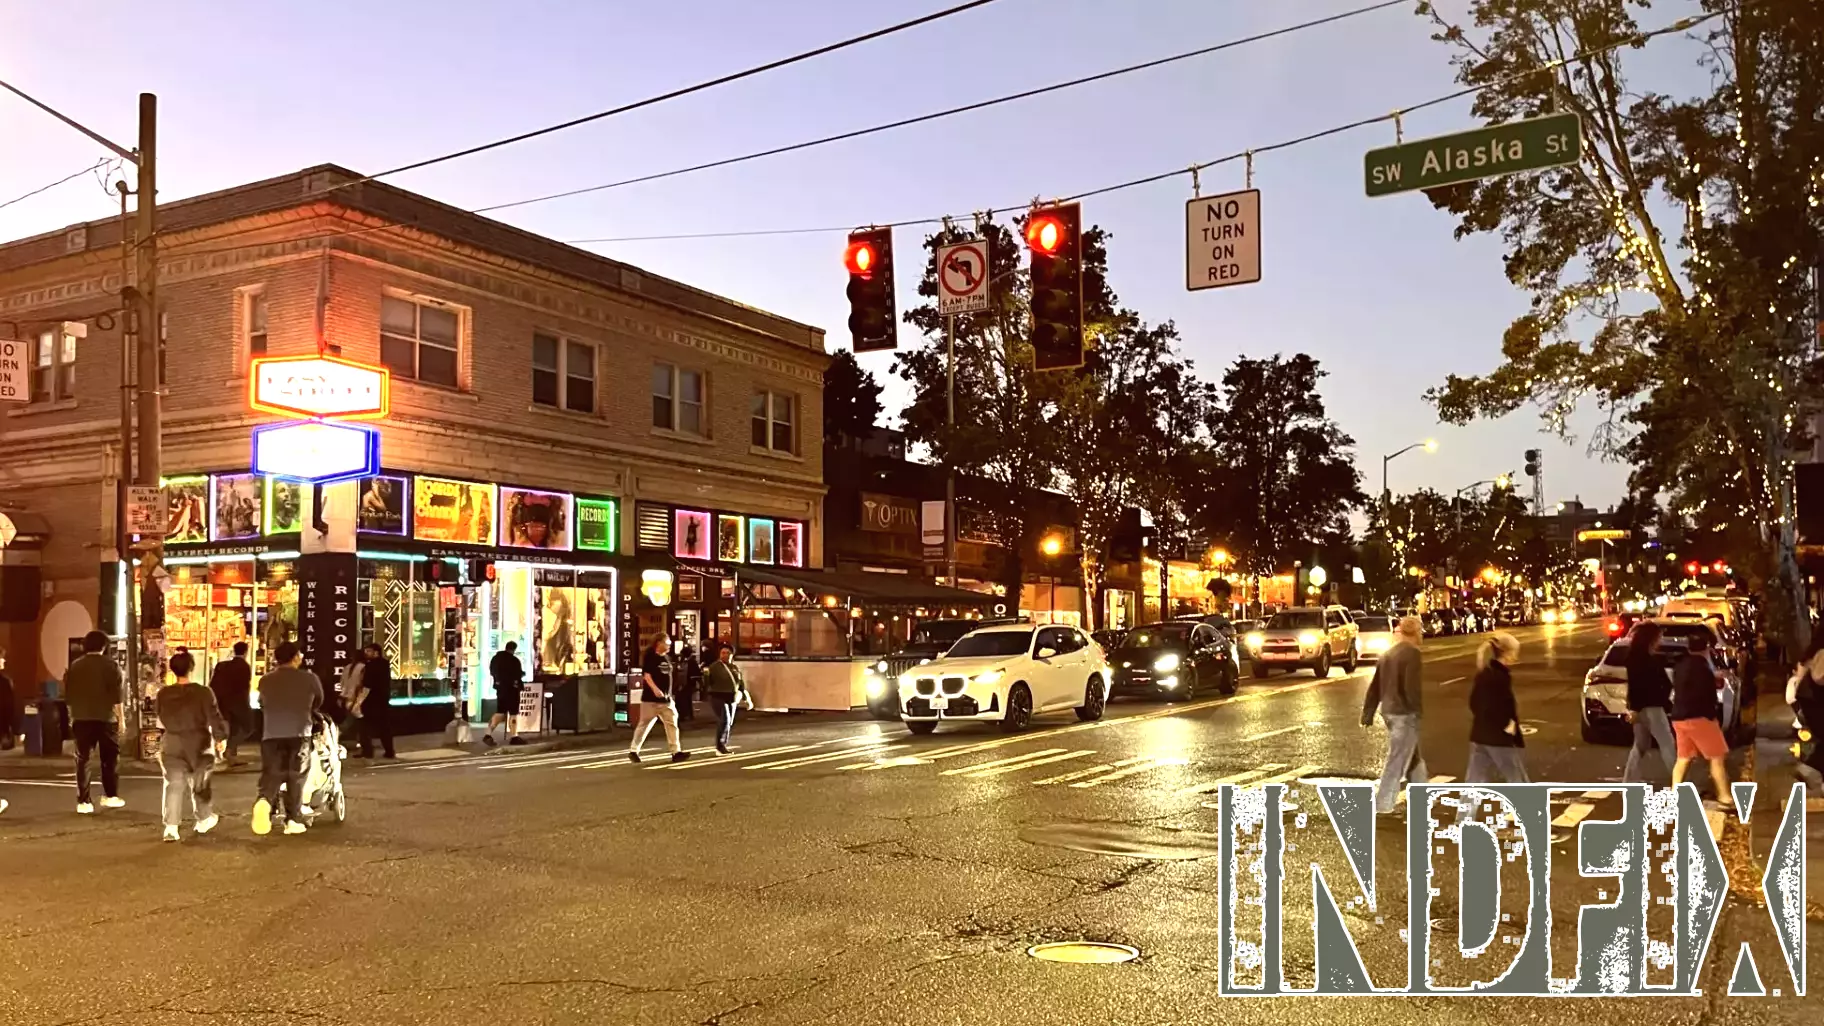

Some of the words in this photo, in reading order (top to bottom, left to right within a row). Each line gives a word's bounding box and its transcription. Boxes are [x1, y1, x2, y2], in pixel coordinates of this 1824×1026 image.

[1372, 163, 1401, 185] SW
[1421, 138, 1523, 176] Alaska
[1546, 133, 1569, 154] St
[1207, 200, 1240, 222] NO
[1202, 222, 1245, 242] TURN
[1212, 244, 1234, 261] ON
[1208, 263, 1240, 281] RED
[0, 343, 14, 356] O
[0, 360, 19, 370] RN
[1, 386, 16, 396] ED
[877, 504, 918, 529] OPTIX
[219, 546, 269, 555] RECORDS
[511, 554, 563, 564] RECORDS
[307, 625, 315, 652] ALL
[333, 585, 348, 692] RECORDS
[623, 594, 632, 666] DISTRICT
